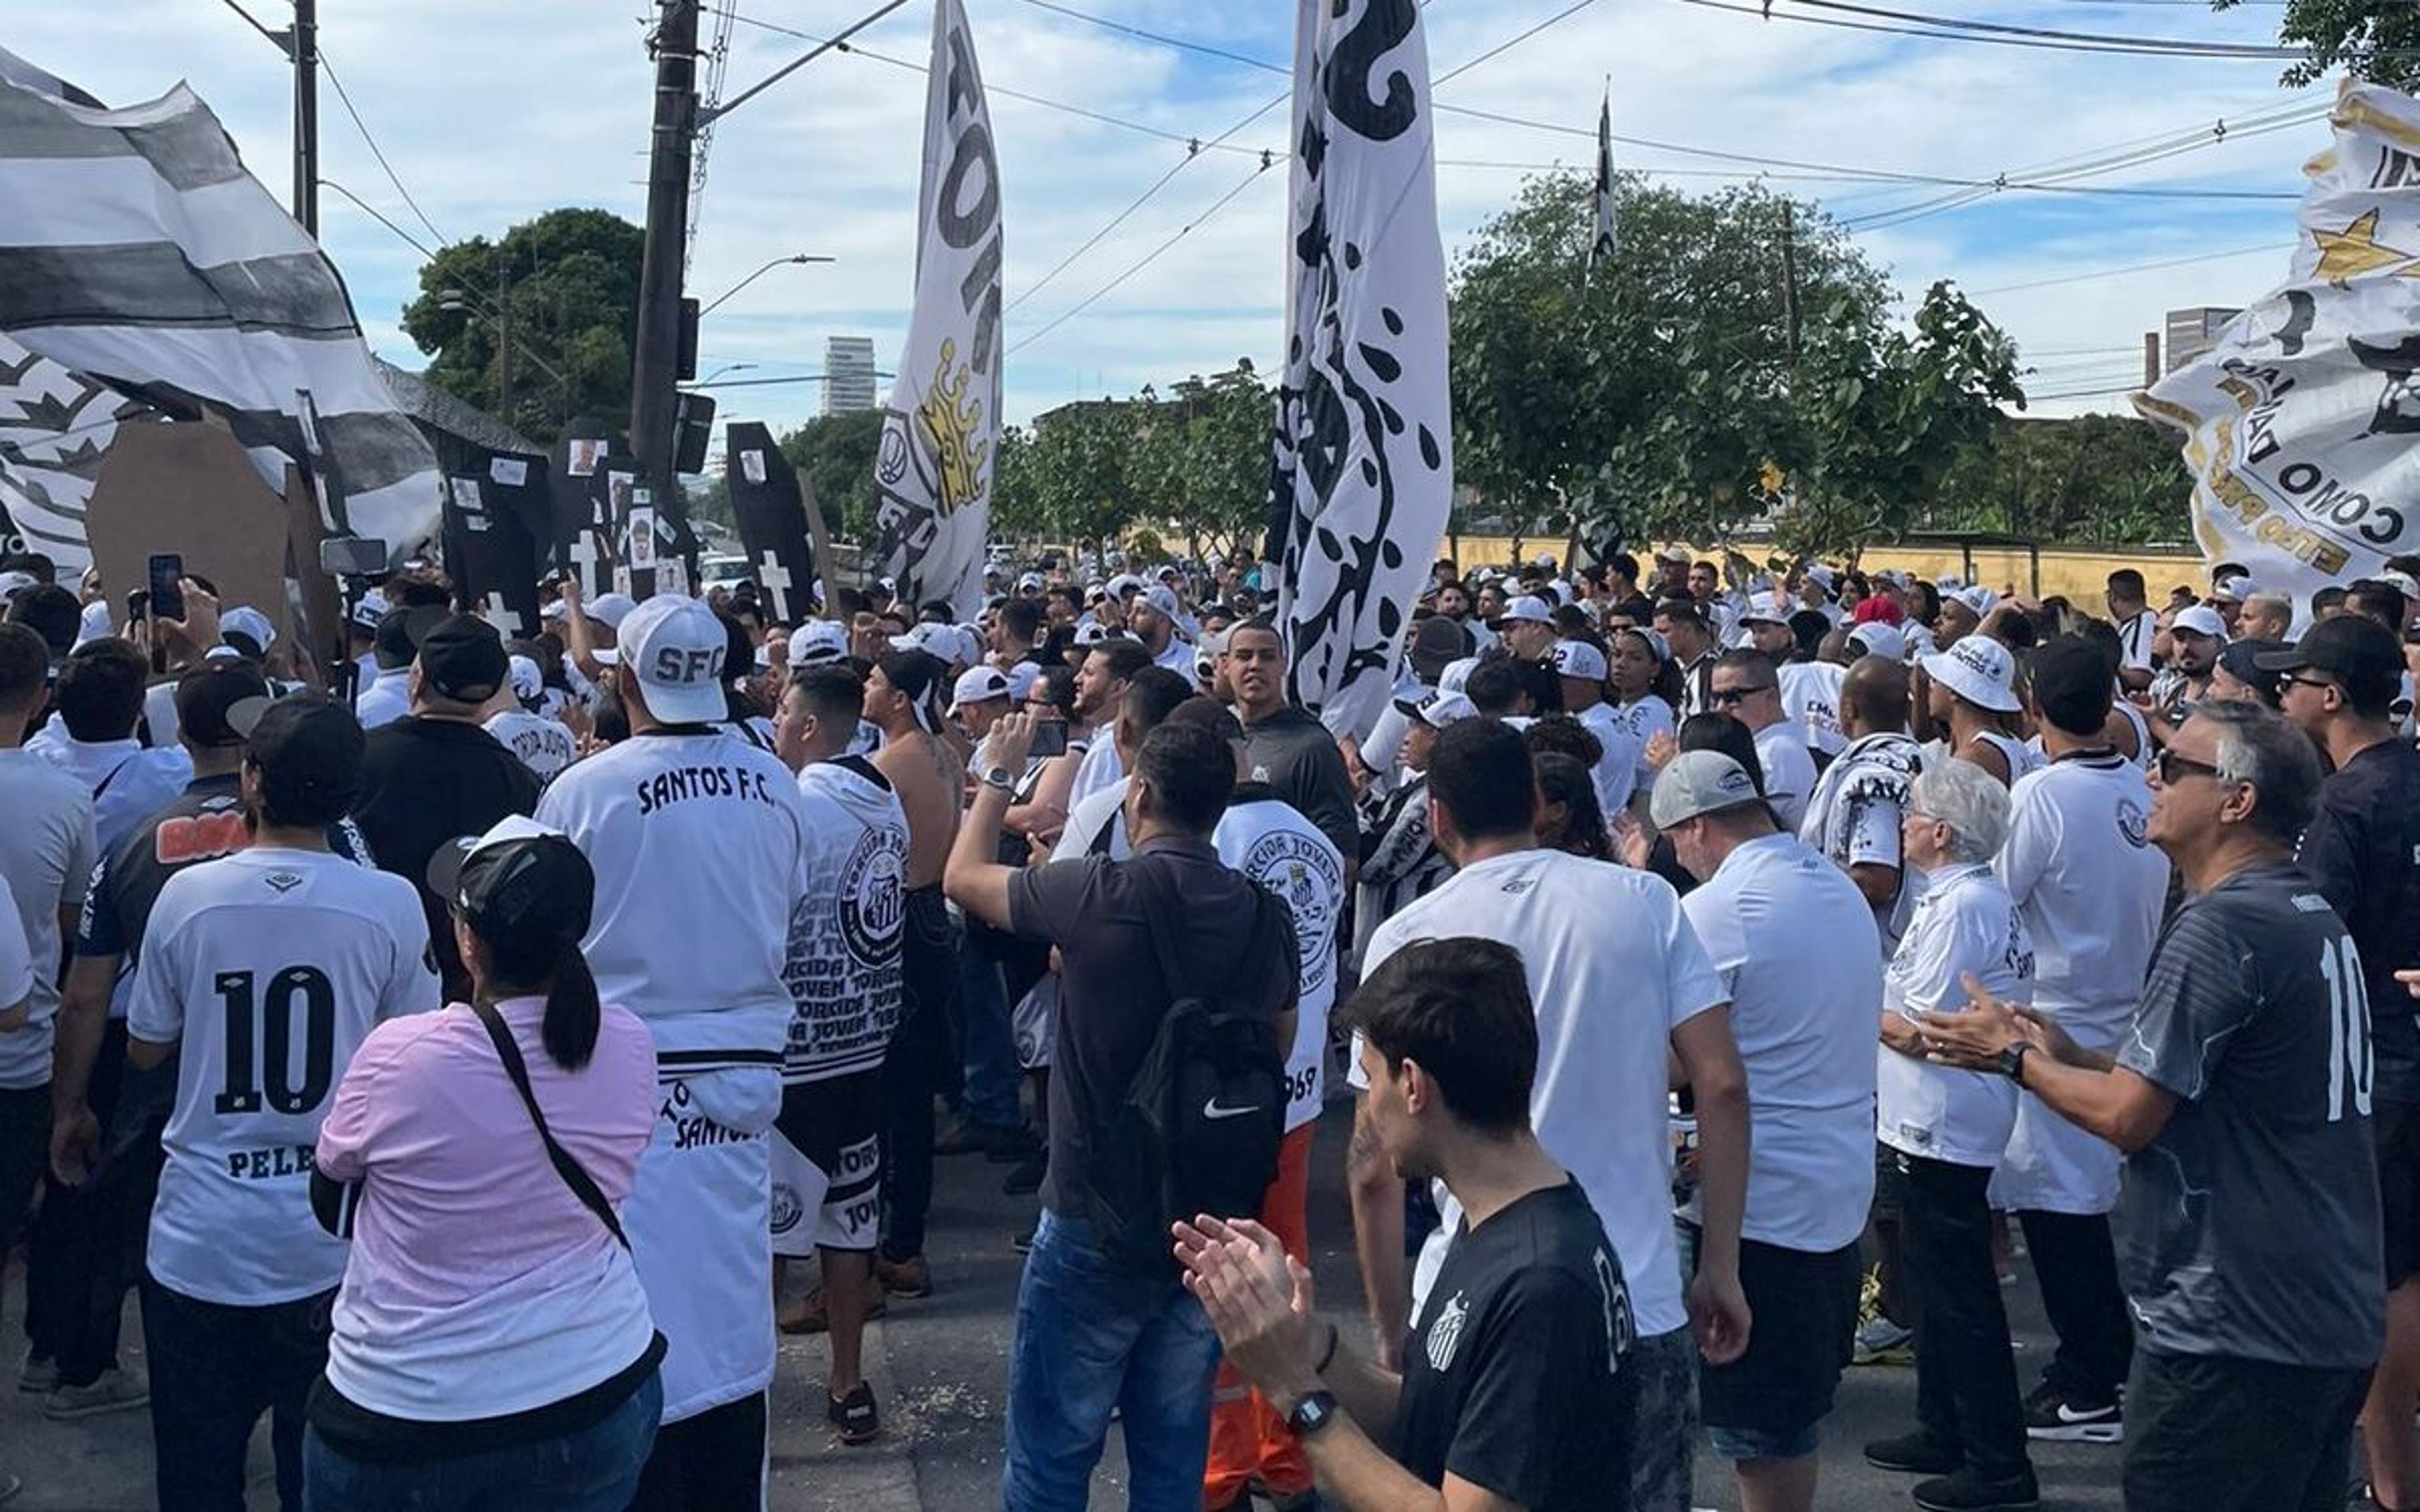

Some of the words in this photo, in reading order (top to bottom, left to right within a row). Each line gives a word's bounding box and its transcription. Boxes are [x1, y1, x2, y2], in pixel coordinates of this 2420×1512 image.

[656, 645, 725, 683] SFC
[638, 767, 733, 815] SANTOS
[735, 767, 775, 807] F.C.
[215, 965, 335, 1115] 10
[2321, 935, 2374, 1121] 10
